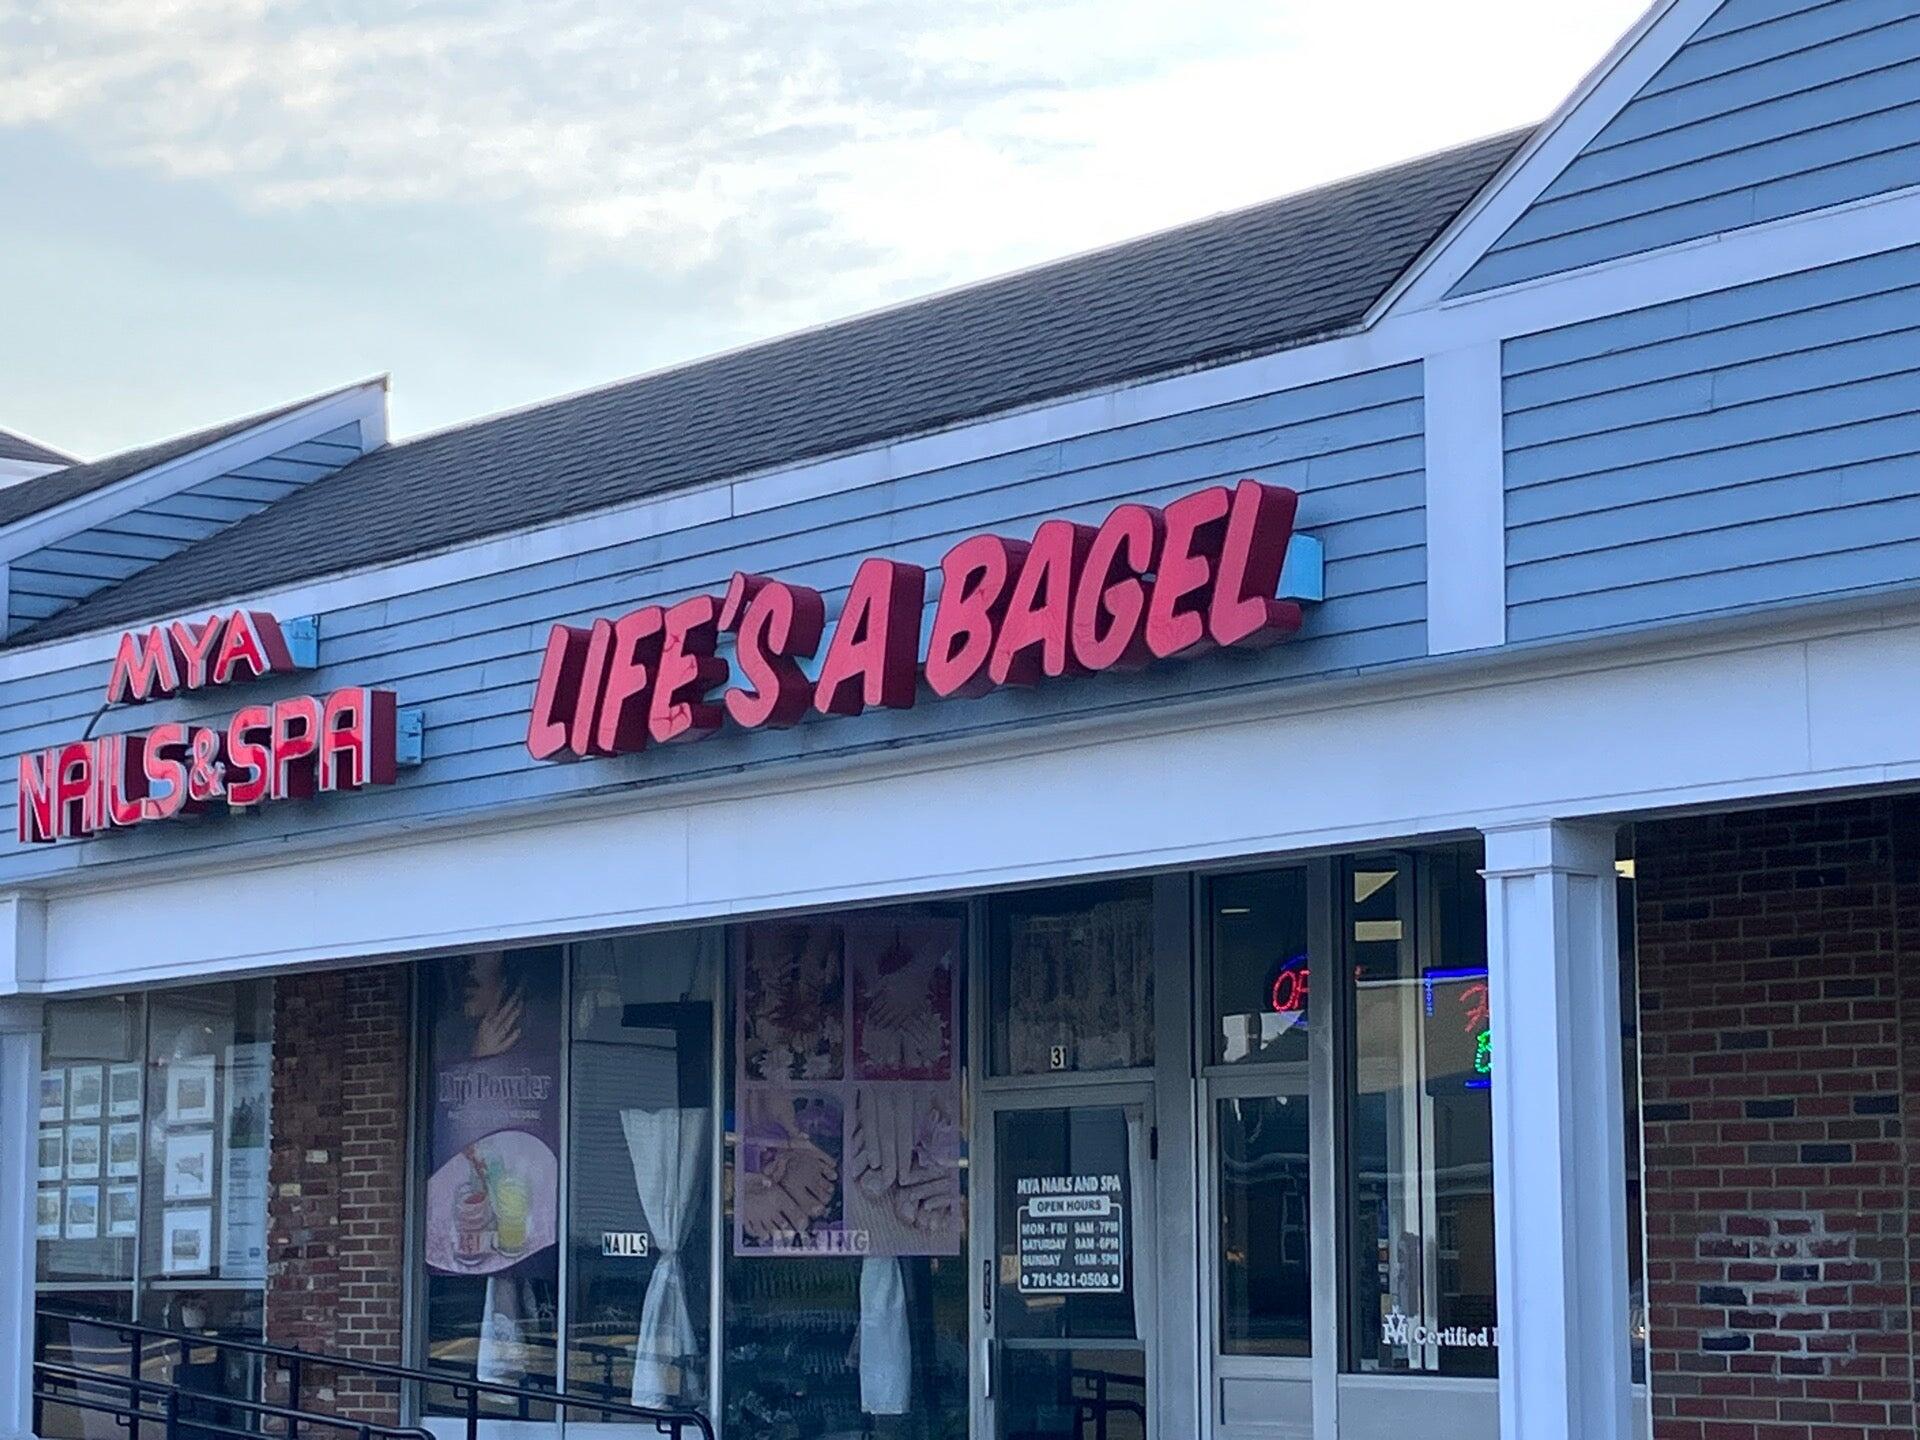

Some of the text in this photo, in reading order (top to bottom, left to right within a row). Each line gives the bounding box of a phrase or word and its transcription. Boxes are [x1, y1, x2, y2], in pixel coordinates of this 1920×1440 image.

[526, 478, 1275, 760] LIFE'S A BAGEL
[107, 609, 277, 704] MYA
[1051, 1047, 1067, 1067] 31
[1017, 1174, 1121, 1194] MYA NAILS AND SPA
[1036, 1199, 1102, 1213] OPEN HOURS
[602, 1233, 646, 1254] NAILS
[1022, 1238, 1067, 1251] SATURDAY
[1022, 1254, 1061, 1266] SUNDAY
[1414, 1326, 1489, 1347] Certified
